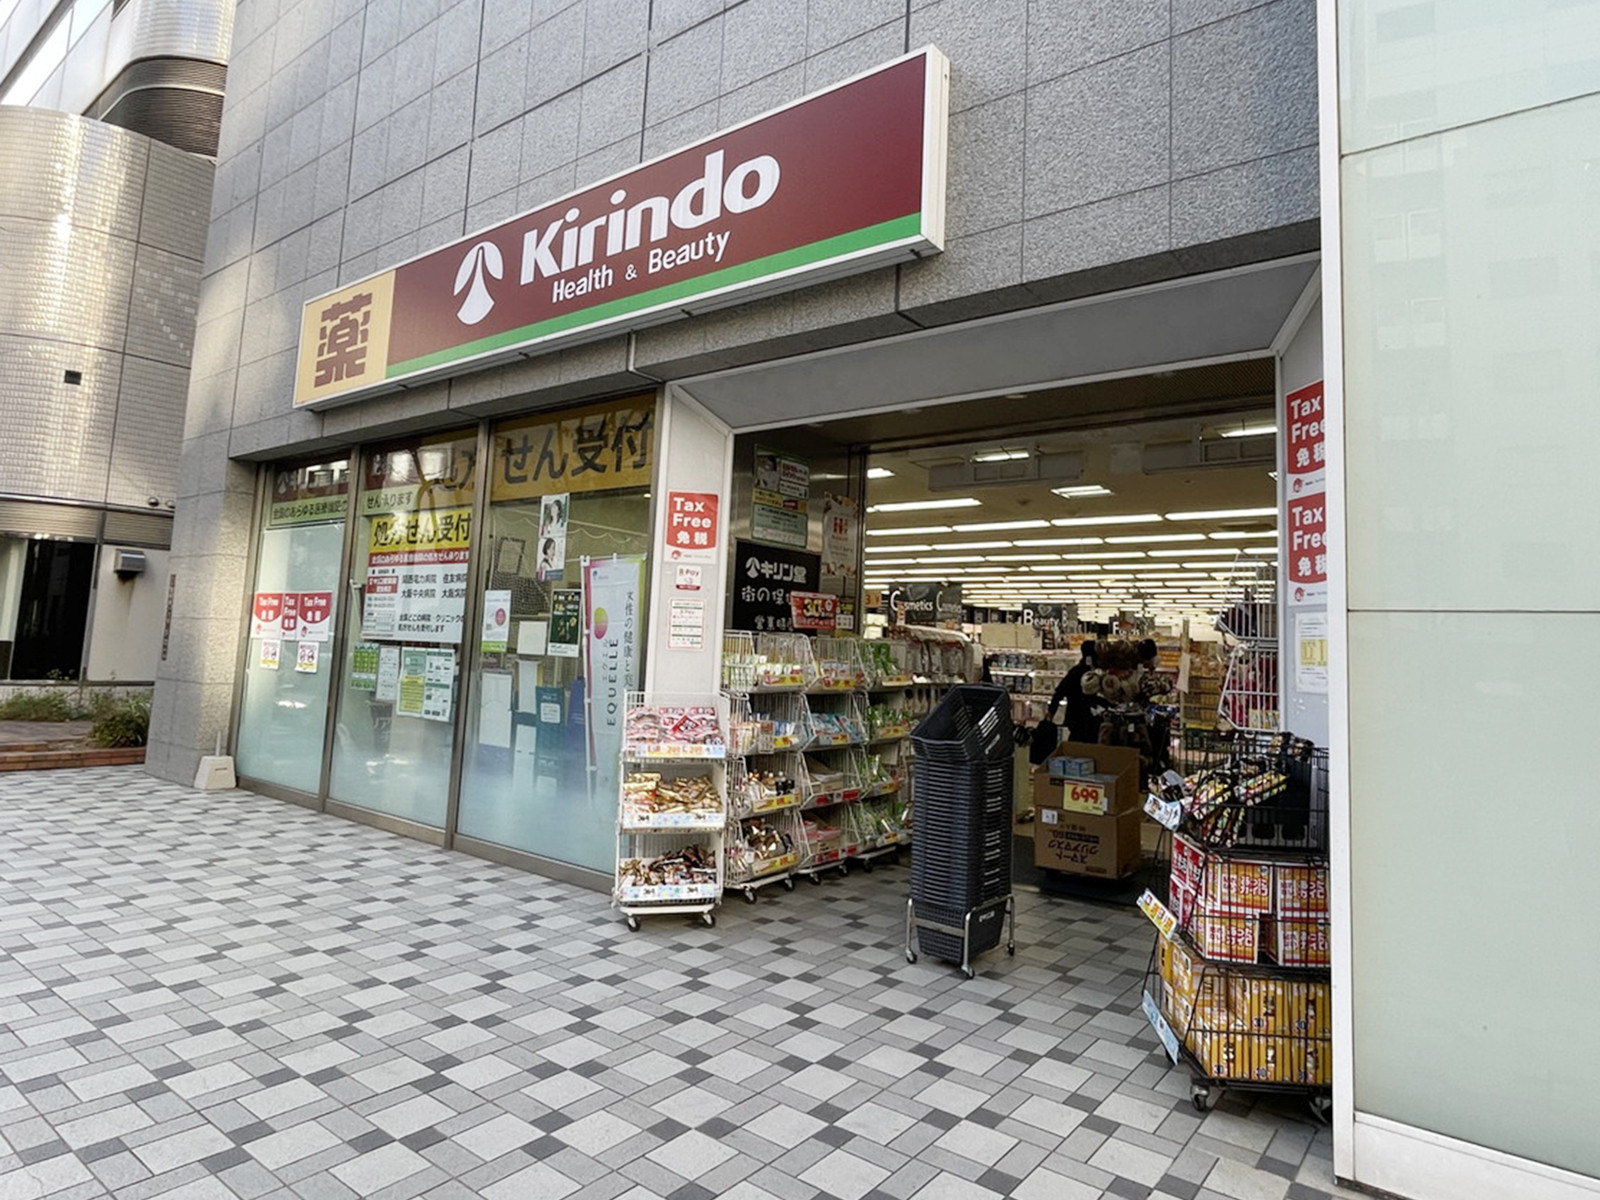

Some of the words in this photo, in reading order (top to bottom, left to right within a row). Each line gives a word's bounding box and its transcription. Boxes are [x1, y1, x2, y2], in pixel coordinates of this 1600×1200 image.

[520, 149, 781, 285] Kirindo
[552, 265, 613, 302] Health
[625, 263, 637, 280] &
[649, 231, 731, 274] Beauty
[1290, 395, 1322, 419] Tax
[674, 497, 704, 512] Tax
[672, 513, 712, 528] Free
[1292, 506, 1323, 527] Tax
[760, 560, 807, 584] キリン堂
[741, 585, 791, 605] 街の保
[890, 590, 934, 612] Csmetics
[1023, 609, 1060, 627] Beauty
[607, 639, 618, 727] EQUELLE
[1070, 786, 1099, 804] 699
